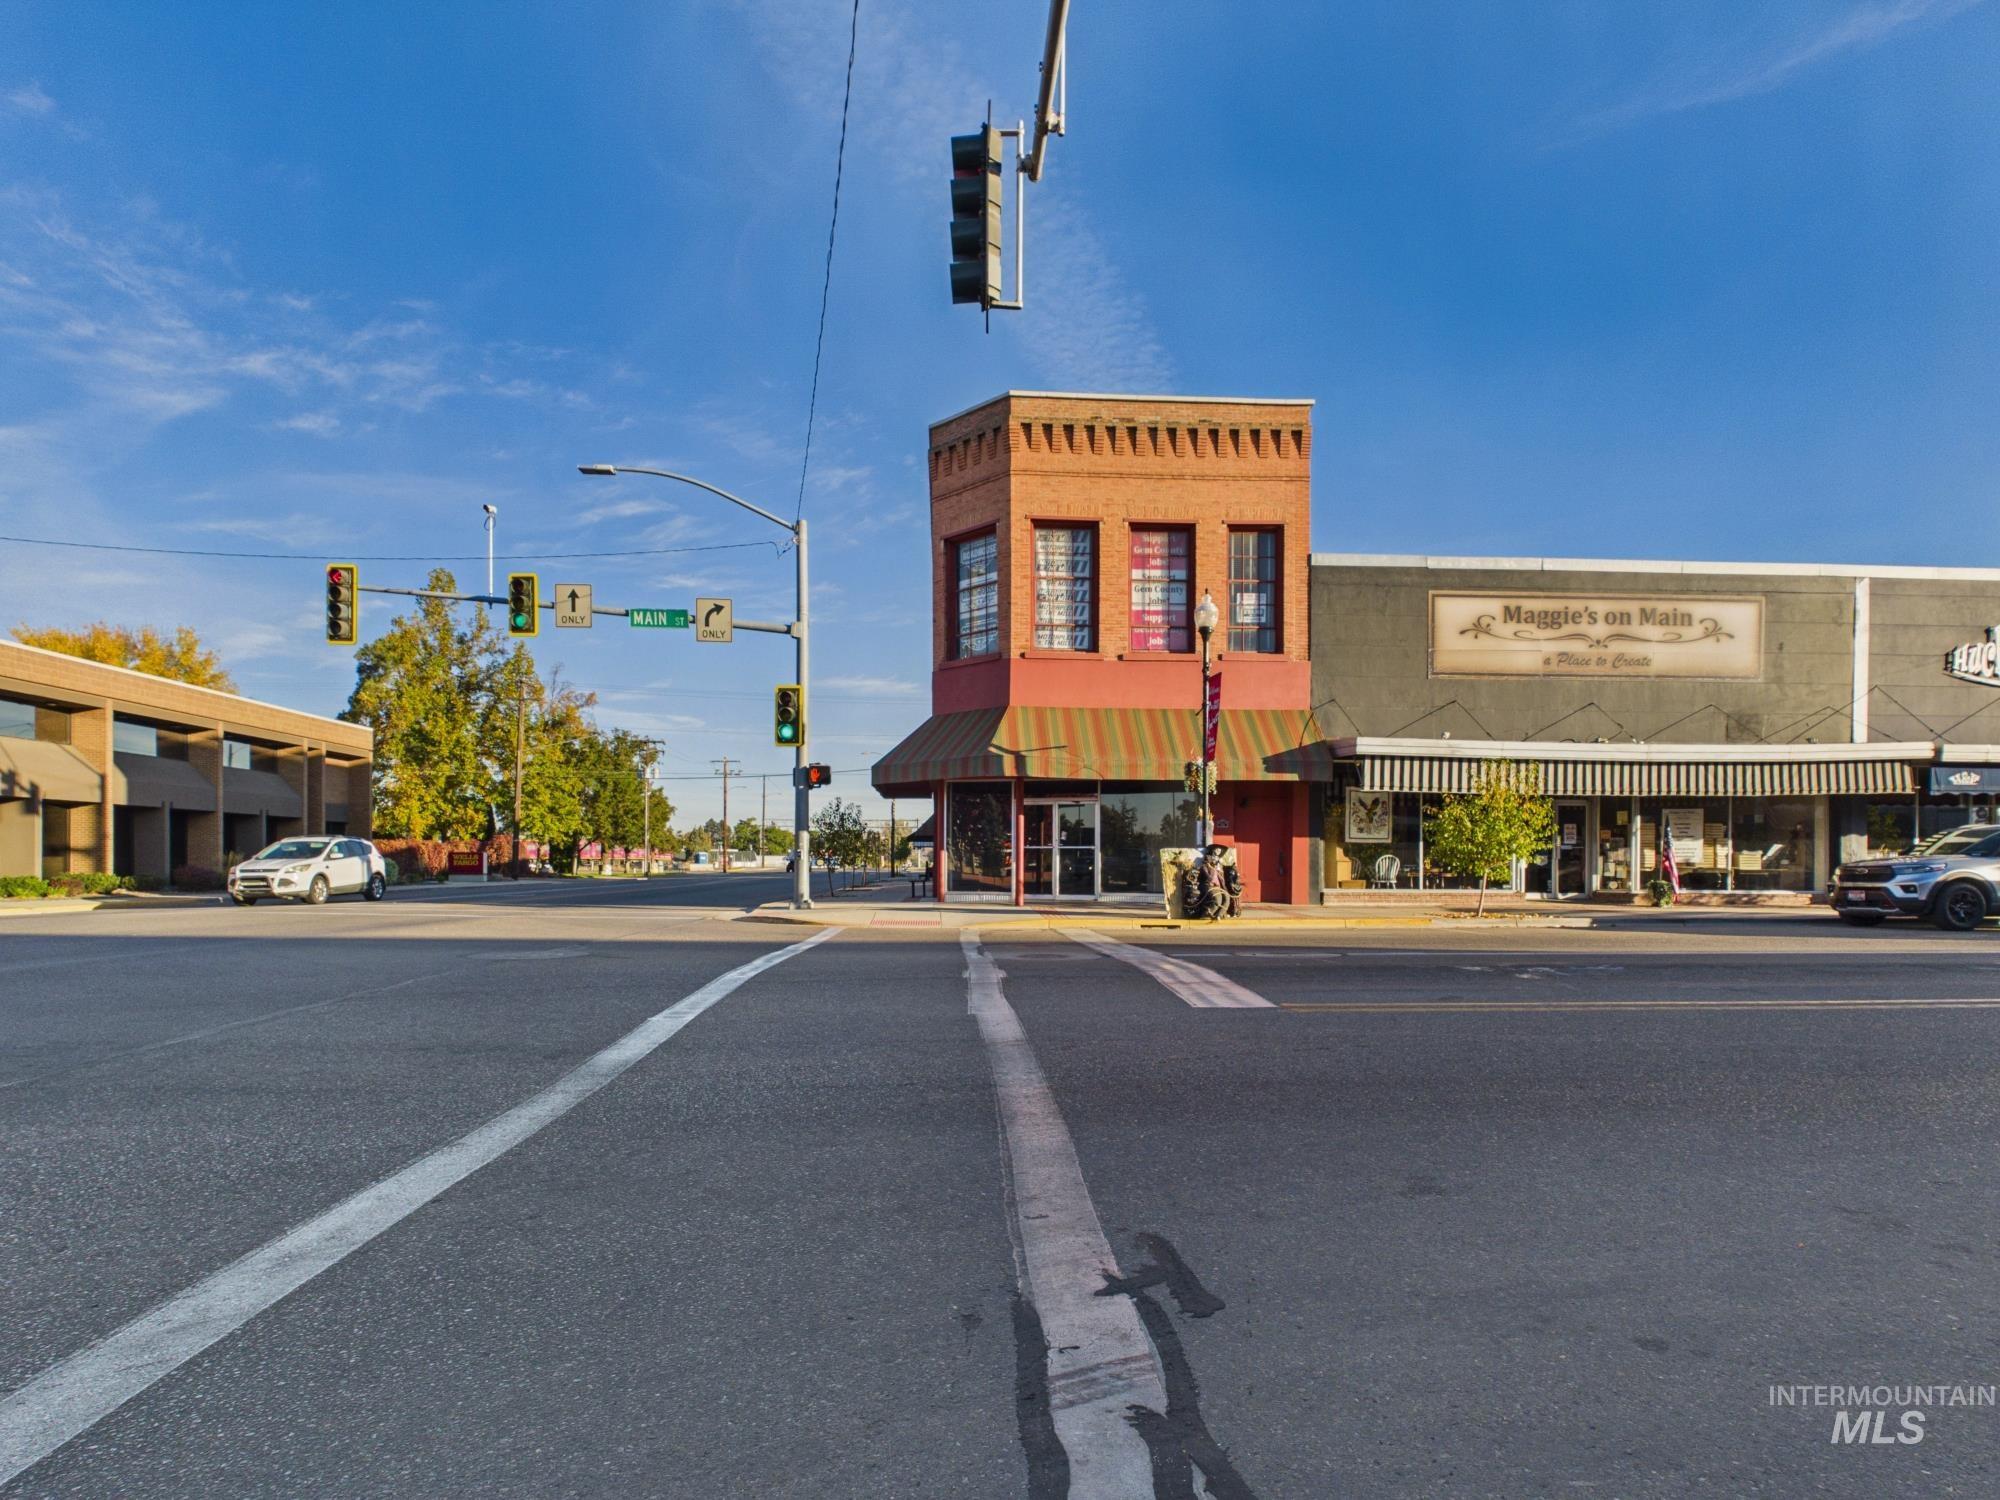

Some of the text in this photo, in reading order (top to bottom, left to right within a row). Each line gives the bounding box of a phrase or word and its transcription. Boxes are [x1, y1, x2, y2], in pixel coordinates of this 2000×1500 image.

[1143, 534, 1176, 545] Suppt
[1134, 546, 1153, 554] Gem
[1134, 584, 1184, 596] Gem County
[561, 615, 586, 624] ONLY
[633, 612, 684, 626] MAIN ST
[1143, 613, 1176, 624] Support
[1503, 605, 1693, 629] Maggie's on Main
[702, 630, 726, 639] ONLY
[1543, 651, 1652, 668] a Place to Create
